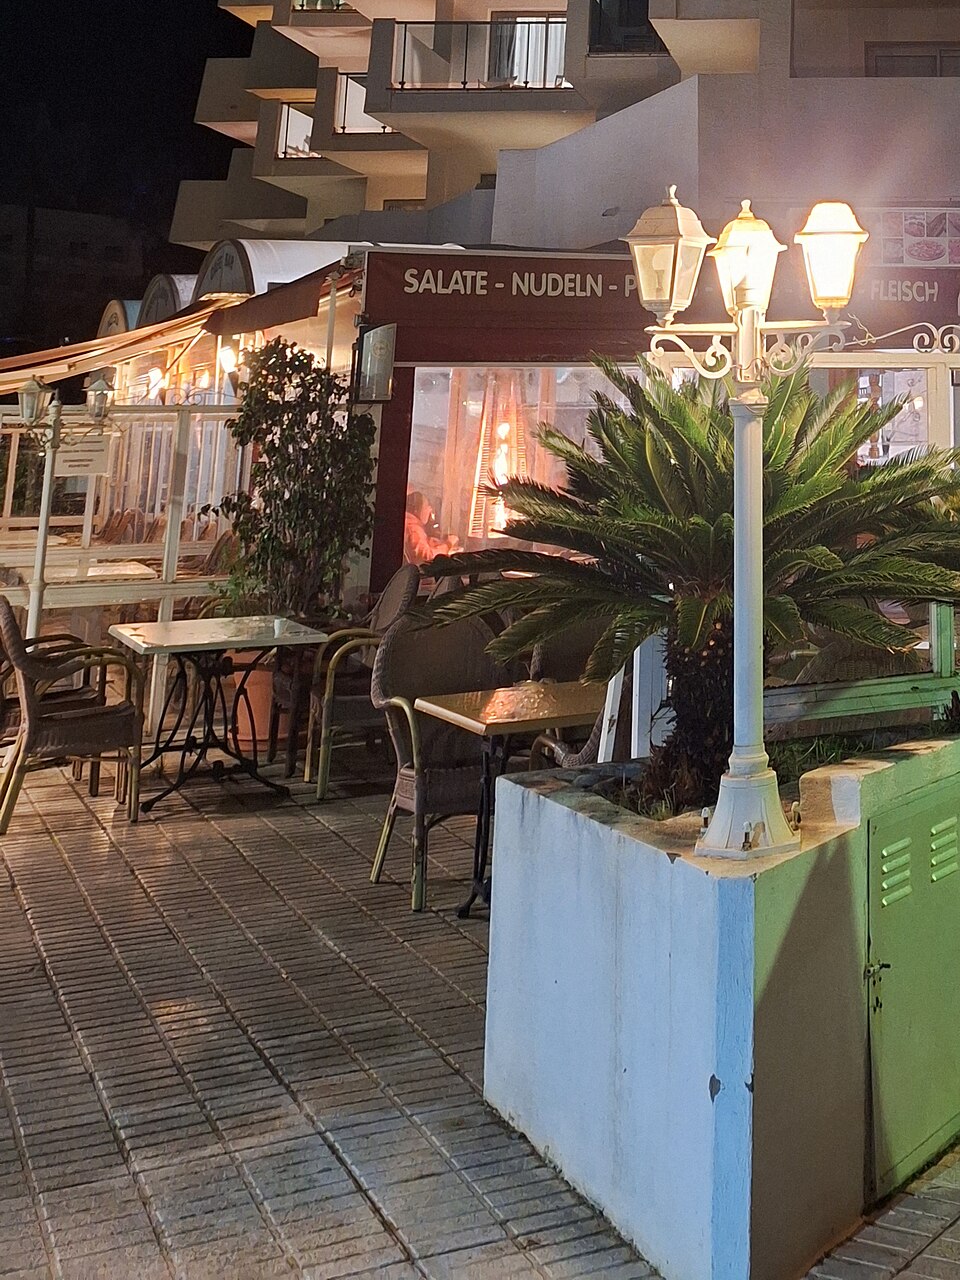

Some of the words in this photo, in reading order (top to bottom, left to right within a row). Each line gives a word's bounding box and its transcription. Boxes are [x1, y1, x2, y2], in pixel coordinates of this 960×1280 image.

[403, 268, 488, 295] SALATE
[511, 271, 603, 297] NUDELN
[869, 279, 939, 303] FLEISCH
